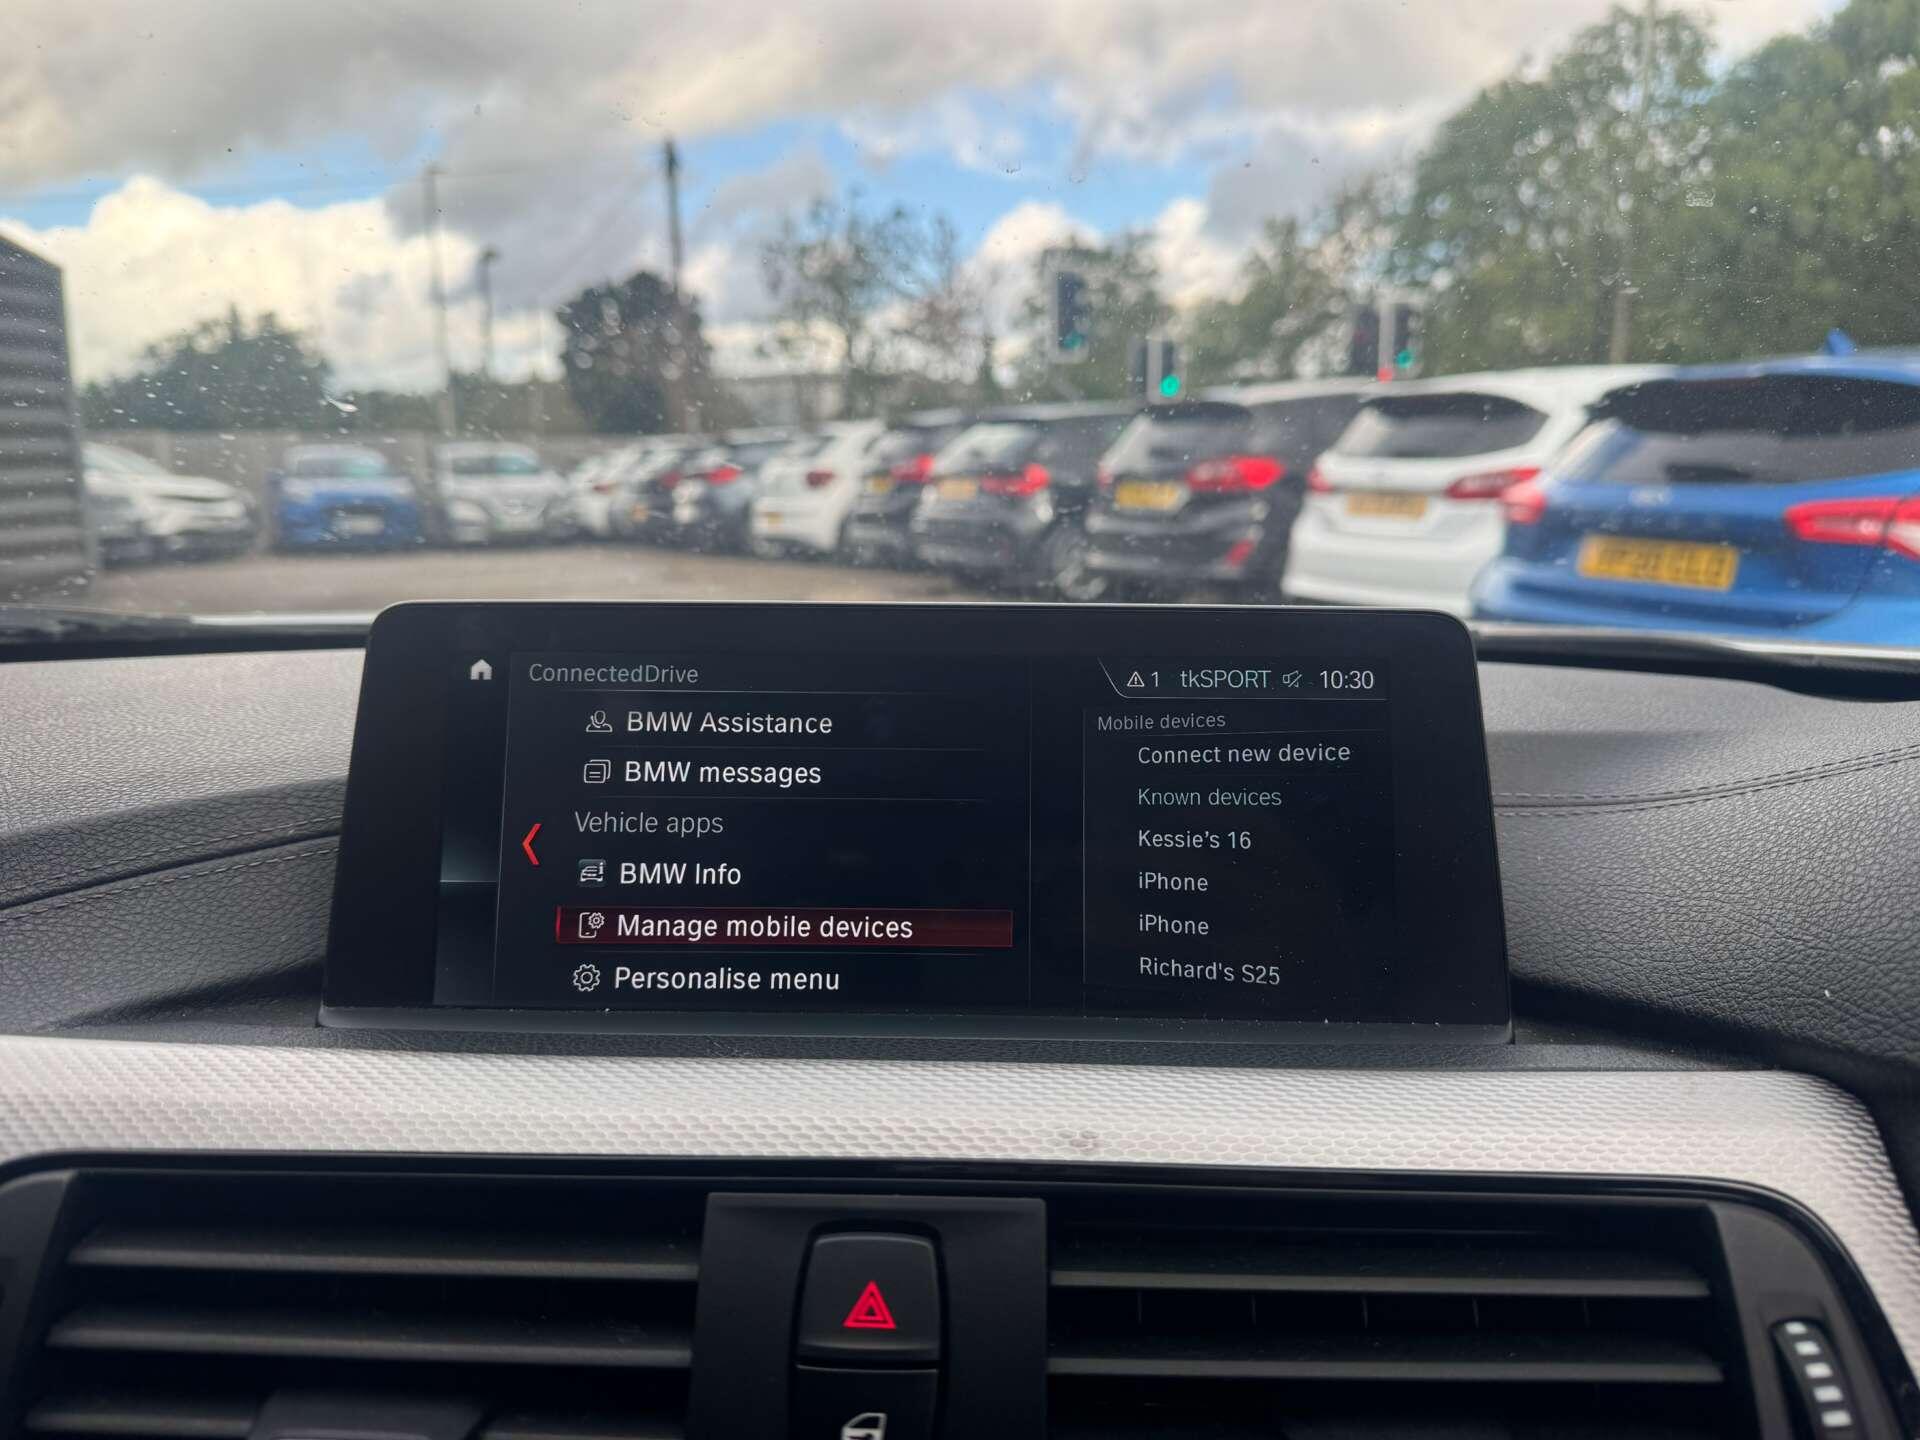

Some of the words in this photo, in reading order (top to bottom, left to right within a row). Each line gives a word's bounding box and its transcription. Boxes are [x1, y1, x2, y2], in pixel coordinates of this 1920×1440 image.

[529, 663, 699, 684] ConnectedDrive
[1151, 671, 1159, 688] 1
[1179, 669, 1274, 690] tkSPORT
[1319, 670, 1374, 690] 10:30
[627, 711, 693, 732] BMW
[699, 711, 833, 734] Assistance
[1098, 714, 1154, 731] Mobile
[1159, 712, 1226, 729] devices
[1138, 746, 1222, 764] Connect
[1228, 748, 1271, 763] new
[1278, 743, 1351, 762] device
[625, 760, 691, 783] BMW
[699, 766, 822, 789] messages
[1138, 788, 1201, 806] Known
[1208, 787, 1282, 806] devices
[574, 811, 659, 833] Vehicle
[666, 816, 724, 838] apps
[1227, 831, 1252, 850] 16
[620, 862, 687, 885] BMW
[695, 862, 742, 885] Info
[1139, 871, 1209, 892] iPhone
[617, 914, 718, 942] Manage
[726, 915, 811, 938] mobile
[819, 915, 913, 939] devices
[1139, 913, 1209, 935] iPhone
[614, 966, 761, 990] Personalise
[770, 972, 839, 991] menu
[1139, 956, 1235, 982] Richard's
[1241, 963, 1280, 985] S25
